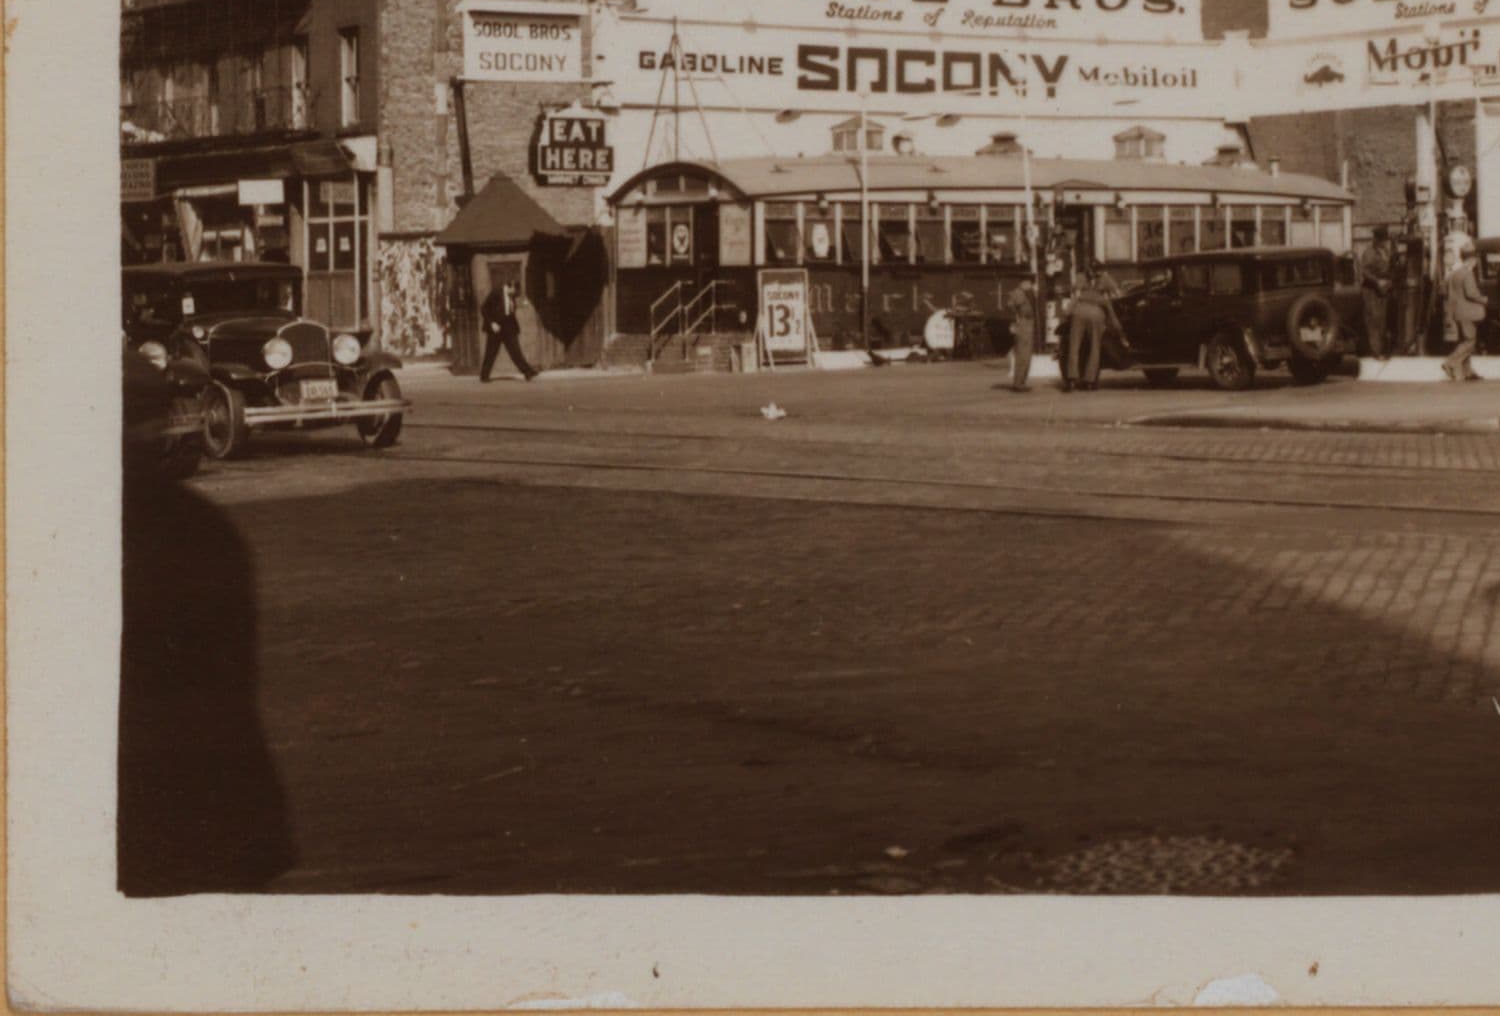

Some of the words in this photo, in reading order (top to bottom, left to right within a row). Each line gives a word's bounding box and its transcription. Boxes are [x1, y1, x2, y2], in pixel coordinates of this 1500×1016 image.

[826, 1, 904, 22] Stations
[923, 7, 943, 28] of
[961, 9, 1058, 31] Reputation
[1394, 1, 1456, 20] Stations
[473, 20, 521, 39] SOBOL
[529, 24, 572, 41] BROS
[479, 51, 567, 72] SOCONY
[638, 50, 784, 76] GASOLINE
[797, 44, 1070, 99] SOCONY
[1078, 65, 1199, 90] Mobiloil
[553, 120, 601, 142] EAT
[545, 147, 609, 170] HERE
